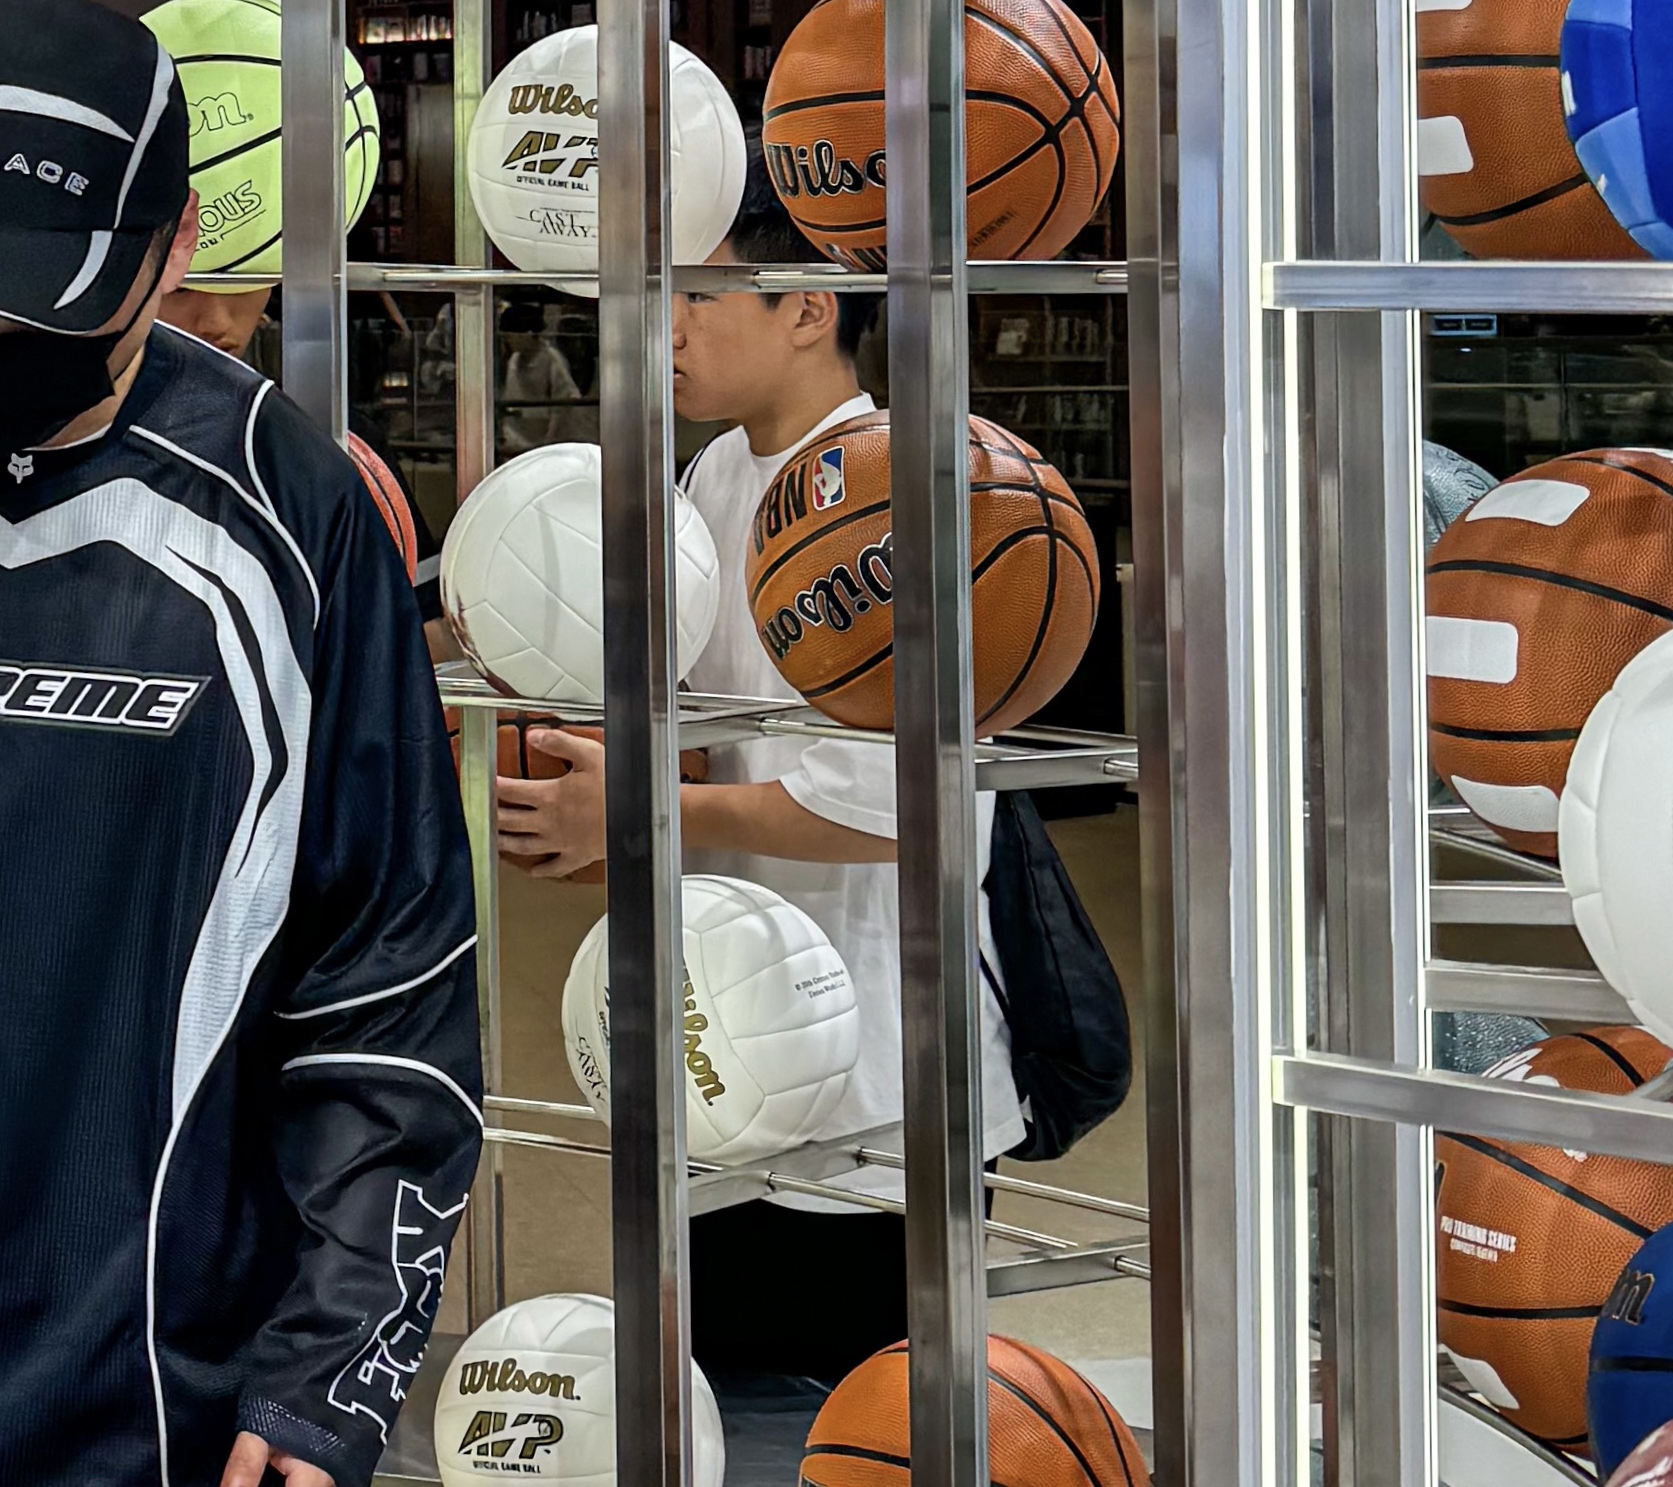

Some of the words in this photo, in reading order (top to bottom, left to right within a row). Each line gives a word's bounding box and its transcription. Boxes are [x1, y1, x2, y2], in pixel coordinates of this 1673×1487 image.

[508, 84, 598, 119] Wilso
[682, 961, 726, 1102] ilson
[460, 1358, 575, 1400] Wilson
[458, 1411, 564, 1460] AVP
